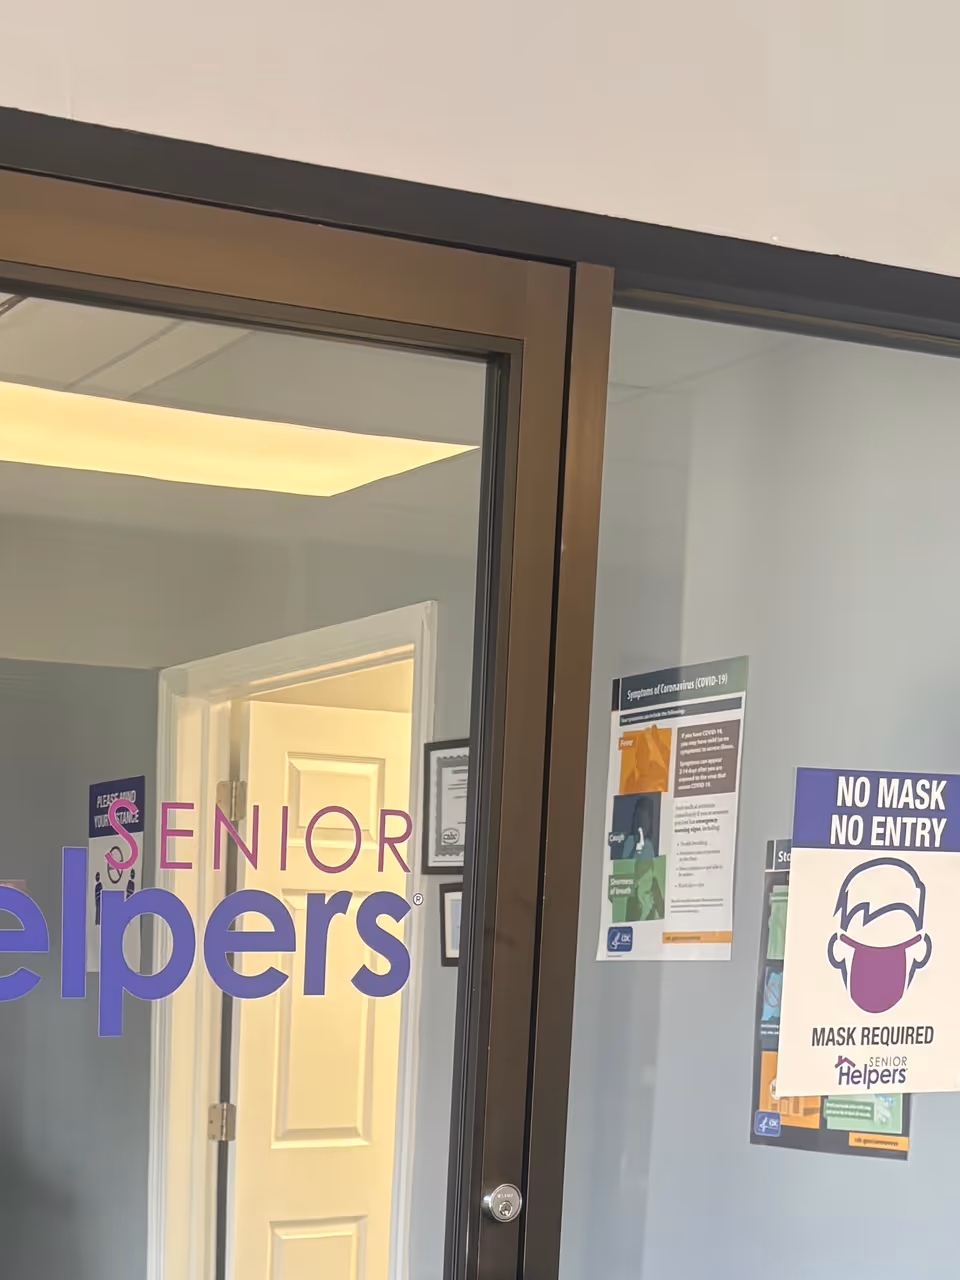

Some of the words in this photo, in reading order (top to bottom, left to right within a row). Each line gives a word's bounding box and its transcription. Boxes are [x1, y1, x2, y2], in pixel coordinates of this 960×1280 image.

[627, 687, 653, 701] Symptoms
[654, 685, 660, 695] of
[661, 680, 694, 694] Coronavirus
[695, 673, 728, 690] (COVID-19)
[836, 776, 870, 808] NO
[877, 778, 947, 811] MASK
[104, 799, 413, 874] SENIOR
[829, 814, 865, 847] NO
[871, 816, 947, 848] ENTRY
[812, 1027, 856, 1047] MASK
[861, 1026, 934, 1046] REQUIRED
[869, 1056, 907, 1067] SENIOR
[837, 1063, 906, 1090] Helpers
